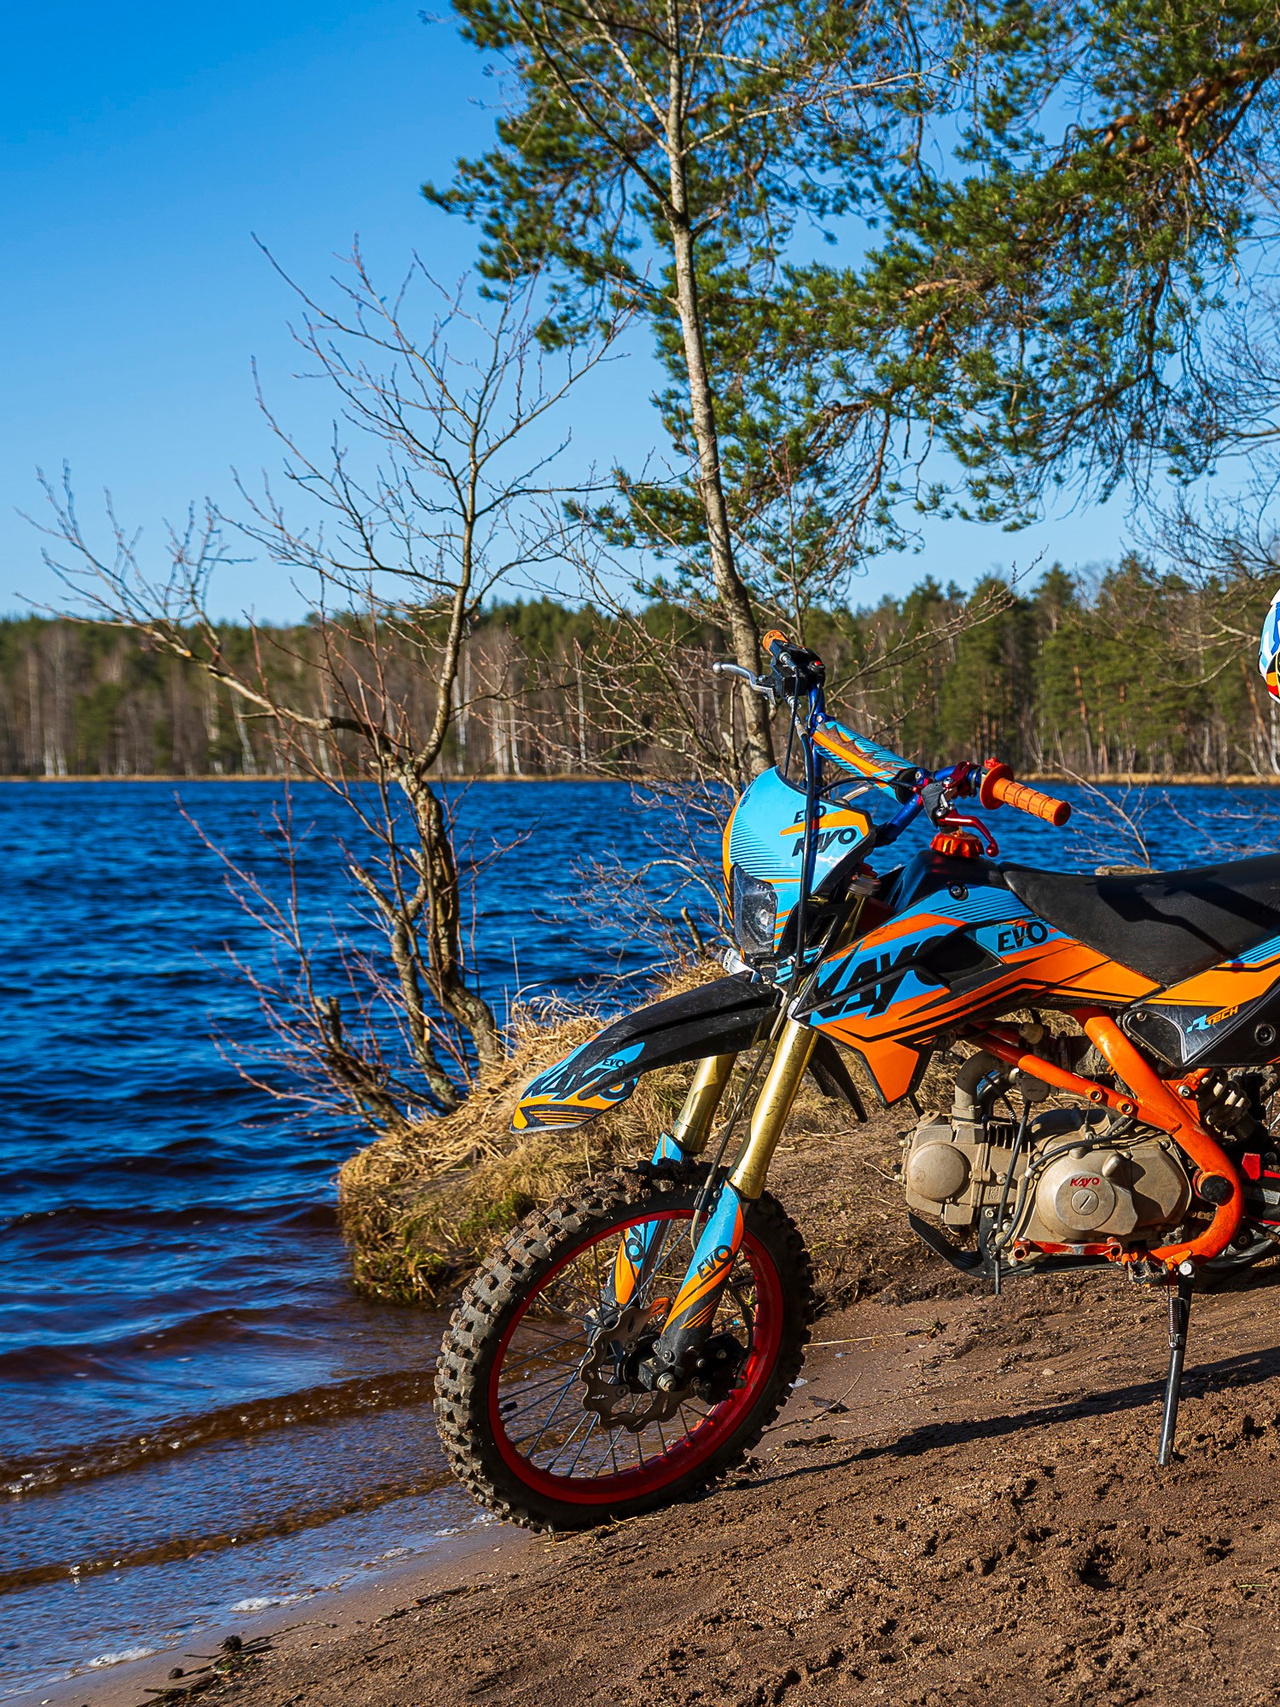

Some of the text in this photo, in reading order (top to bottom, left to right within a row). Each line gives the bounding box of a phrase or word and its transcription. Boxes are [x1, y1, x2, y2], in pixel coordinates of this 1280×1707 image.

[793, 805, 827, 824] EO
[998, 921, 1048, 951] EVO
[602, 1058, 626, 1068] EVO
[1070, 1176, 1101, 1188] KAYO
[697, 1245, 732, 1279] EVO
